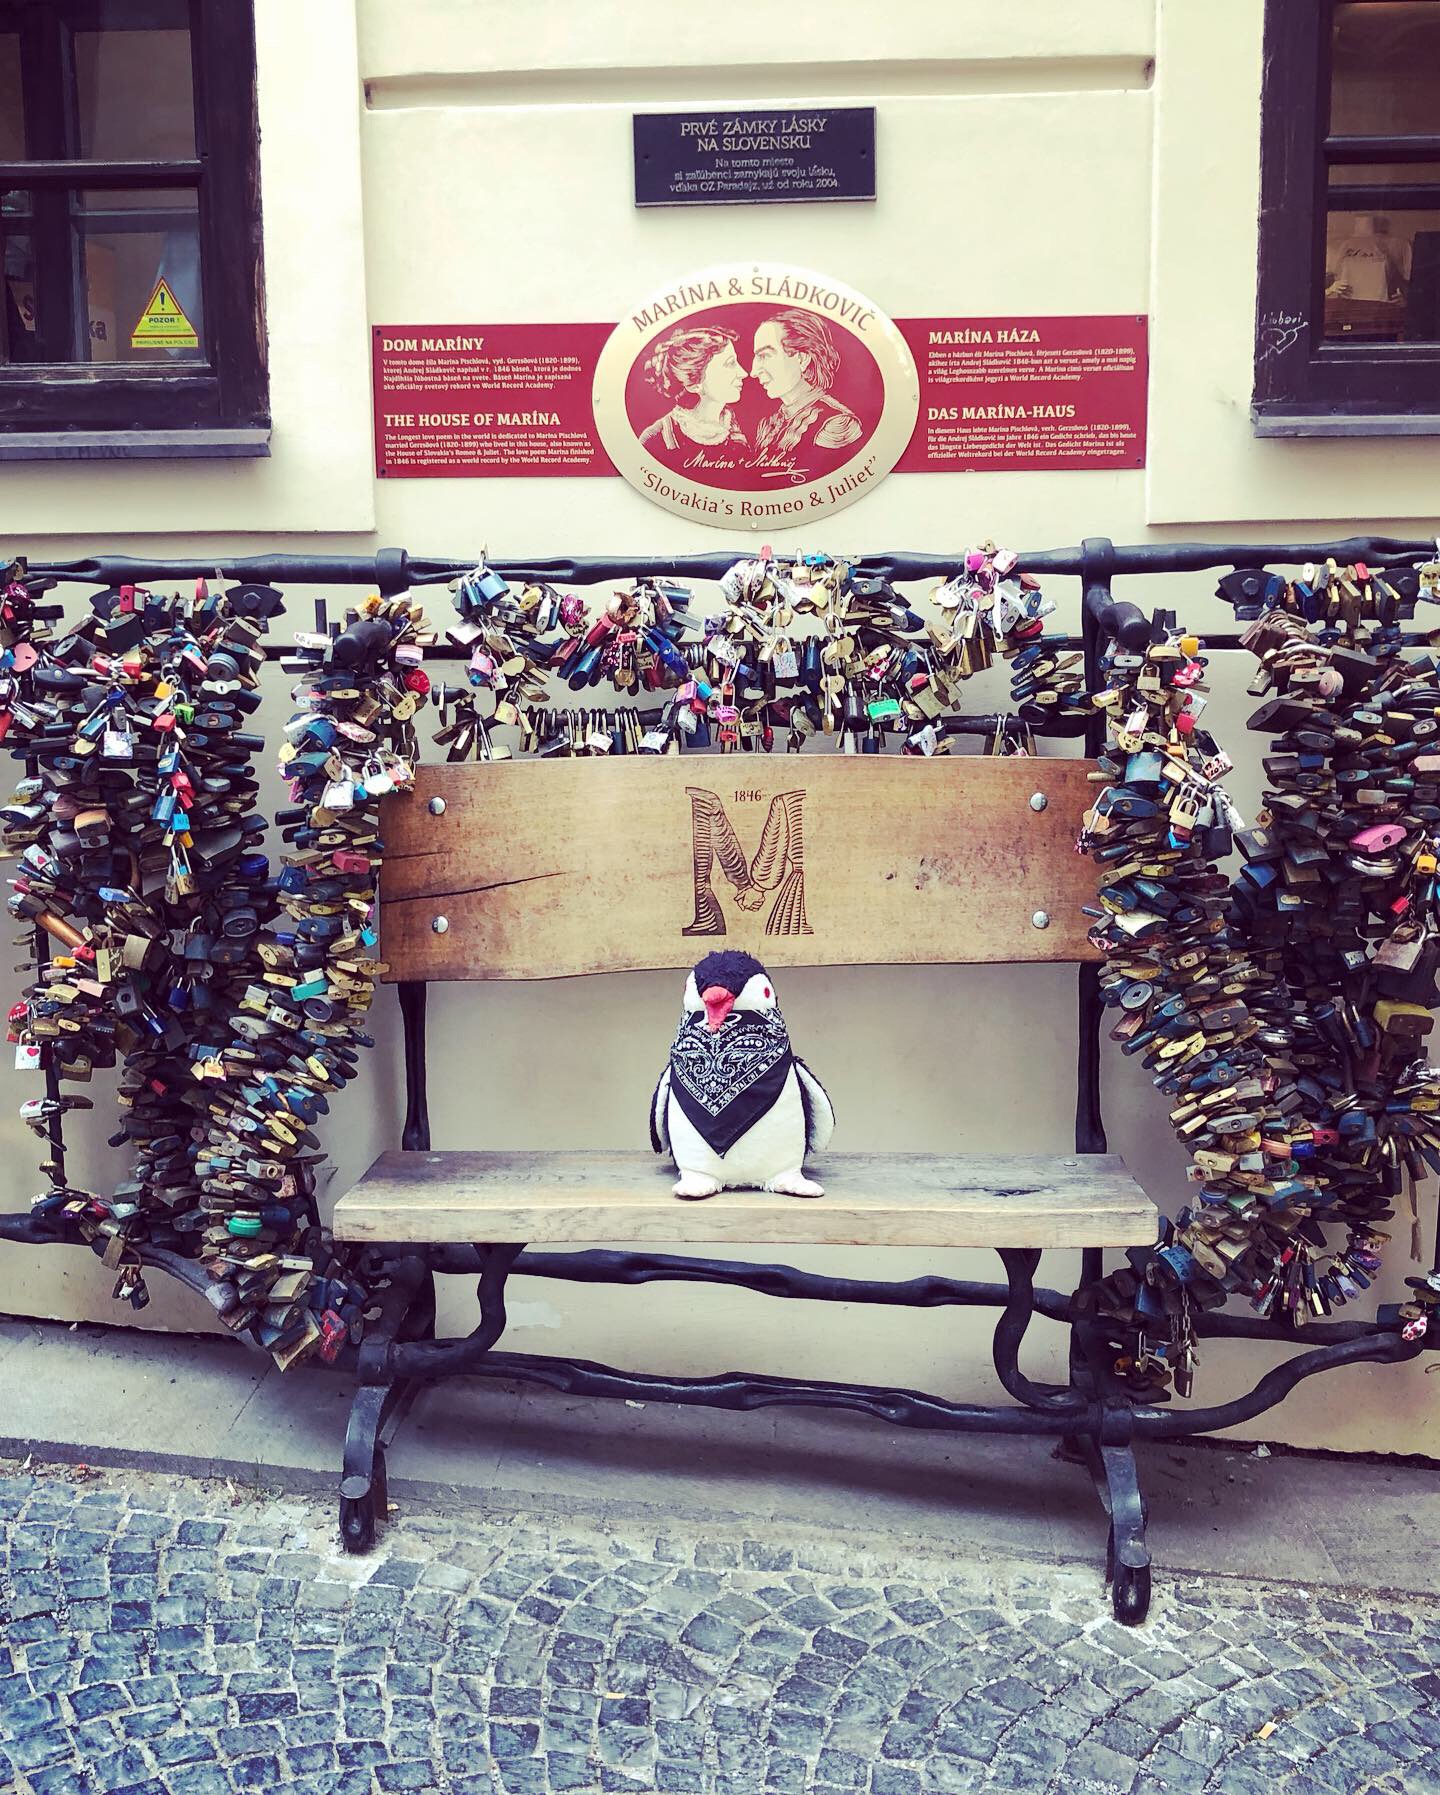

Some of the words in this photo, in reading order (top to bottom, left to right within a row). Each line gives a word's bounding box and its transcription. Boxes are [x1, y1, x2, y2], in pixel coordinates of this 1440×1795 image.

[680, 118, 718, 137] PRVÉ
[722, 117, 778, 135] ZÁMKY
[781, 114, 827, 133] LÁSKY
[697, 138, 719, 152] NA
[722, 135, 811, 151] SLOVENSKU
[715, 158, 729, 168] Na
[732, 159, 760, 168] tomto
[700, 181, 716, 192] OZ
[777, 179, 790, 189] od
[792, 179, 814, 189] roku
[631, 280, 722, 333] MARÍNA
[728, 278, 744, 296] &
[751, 275, 876, 332] SLÁDKOVIČ
[382, 338, 418, 352] DOM
[421, 335, 485, 352] MARÍNY
[928, 328, 994, 344] MARÍNA
[996, 327, 1041, 343] HÁZA
[403, 367, 424, 375] Andrej
[383, 414, 415, 427] THE
[418, 413, 471, 427] HOUSE
[473, 413, 494, 426] OF
[497, 410, 561, 426] MARÍNA
[927, 407, 958, 420] DAS
[961, 403, 1076, 420] MARÍNA-HAUS
[440, 441, 478, 449] (1820-1899)
[417, 458, 448, 466] registered
[500, 457, 509, 465] by
[1058, 450, 1086, 458] Academy
[740, 500, 804, 516] Romeo
[810, 490, 824, 506] &
[733, 790, 762, 802] 1846
